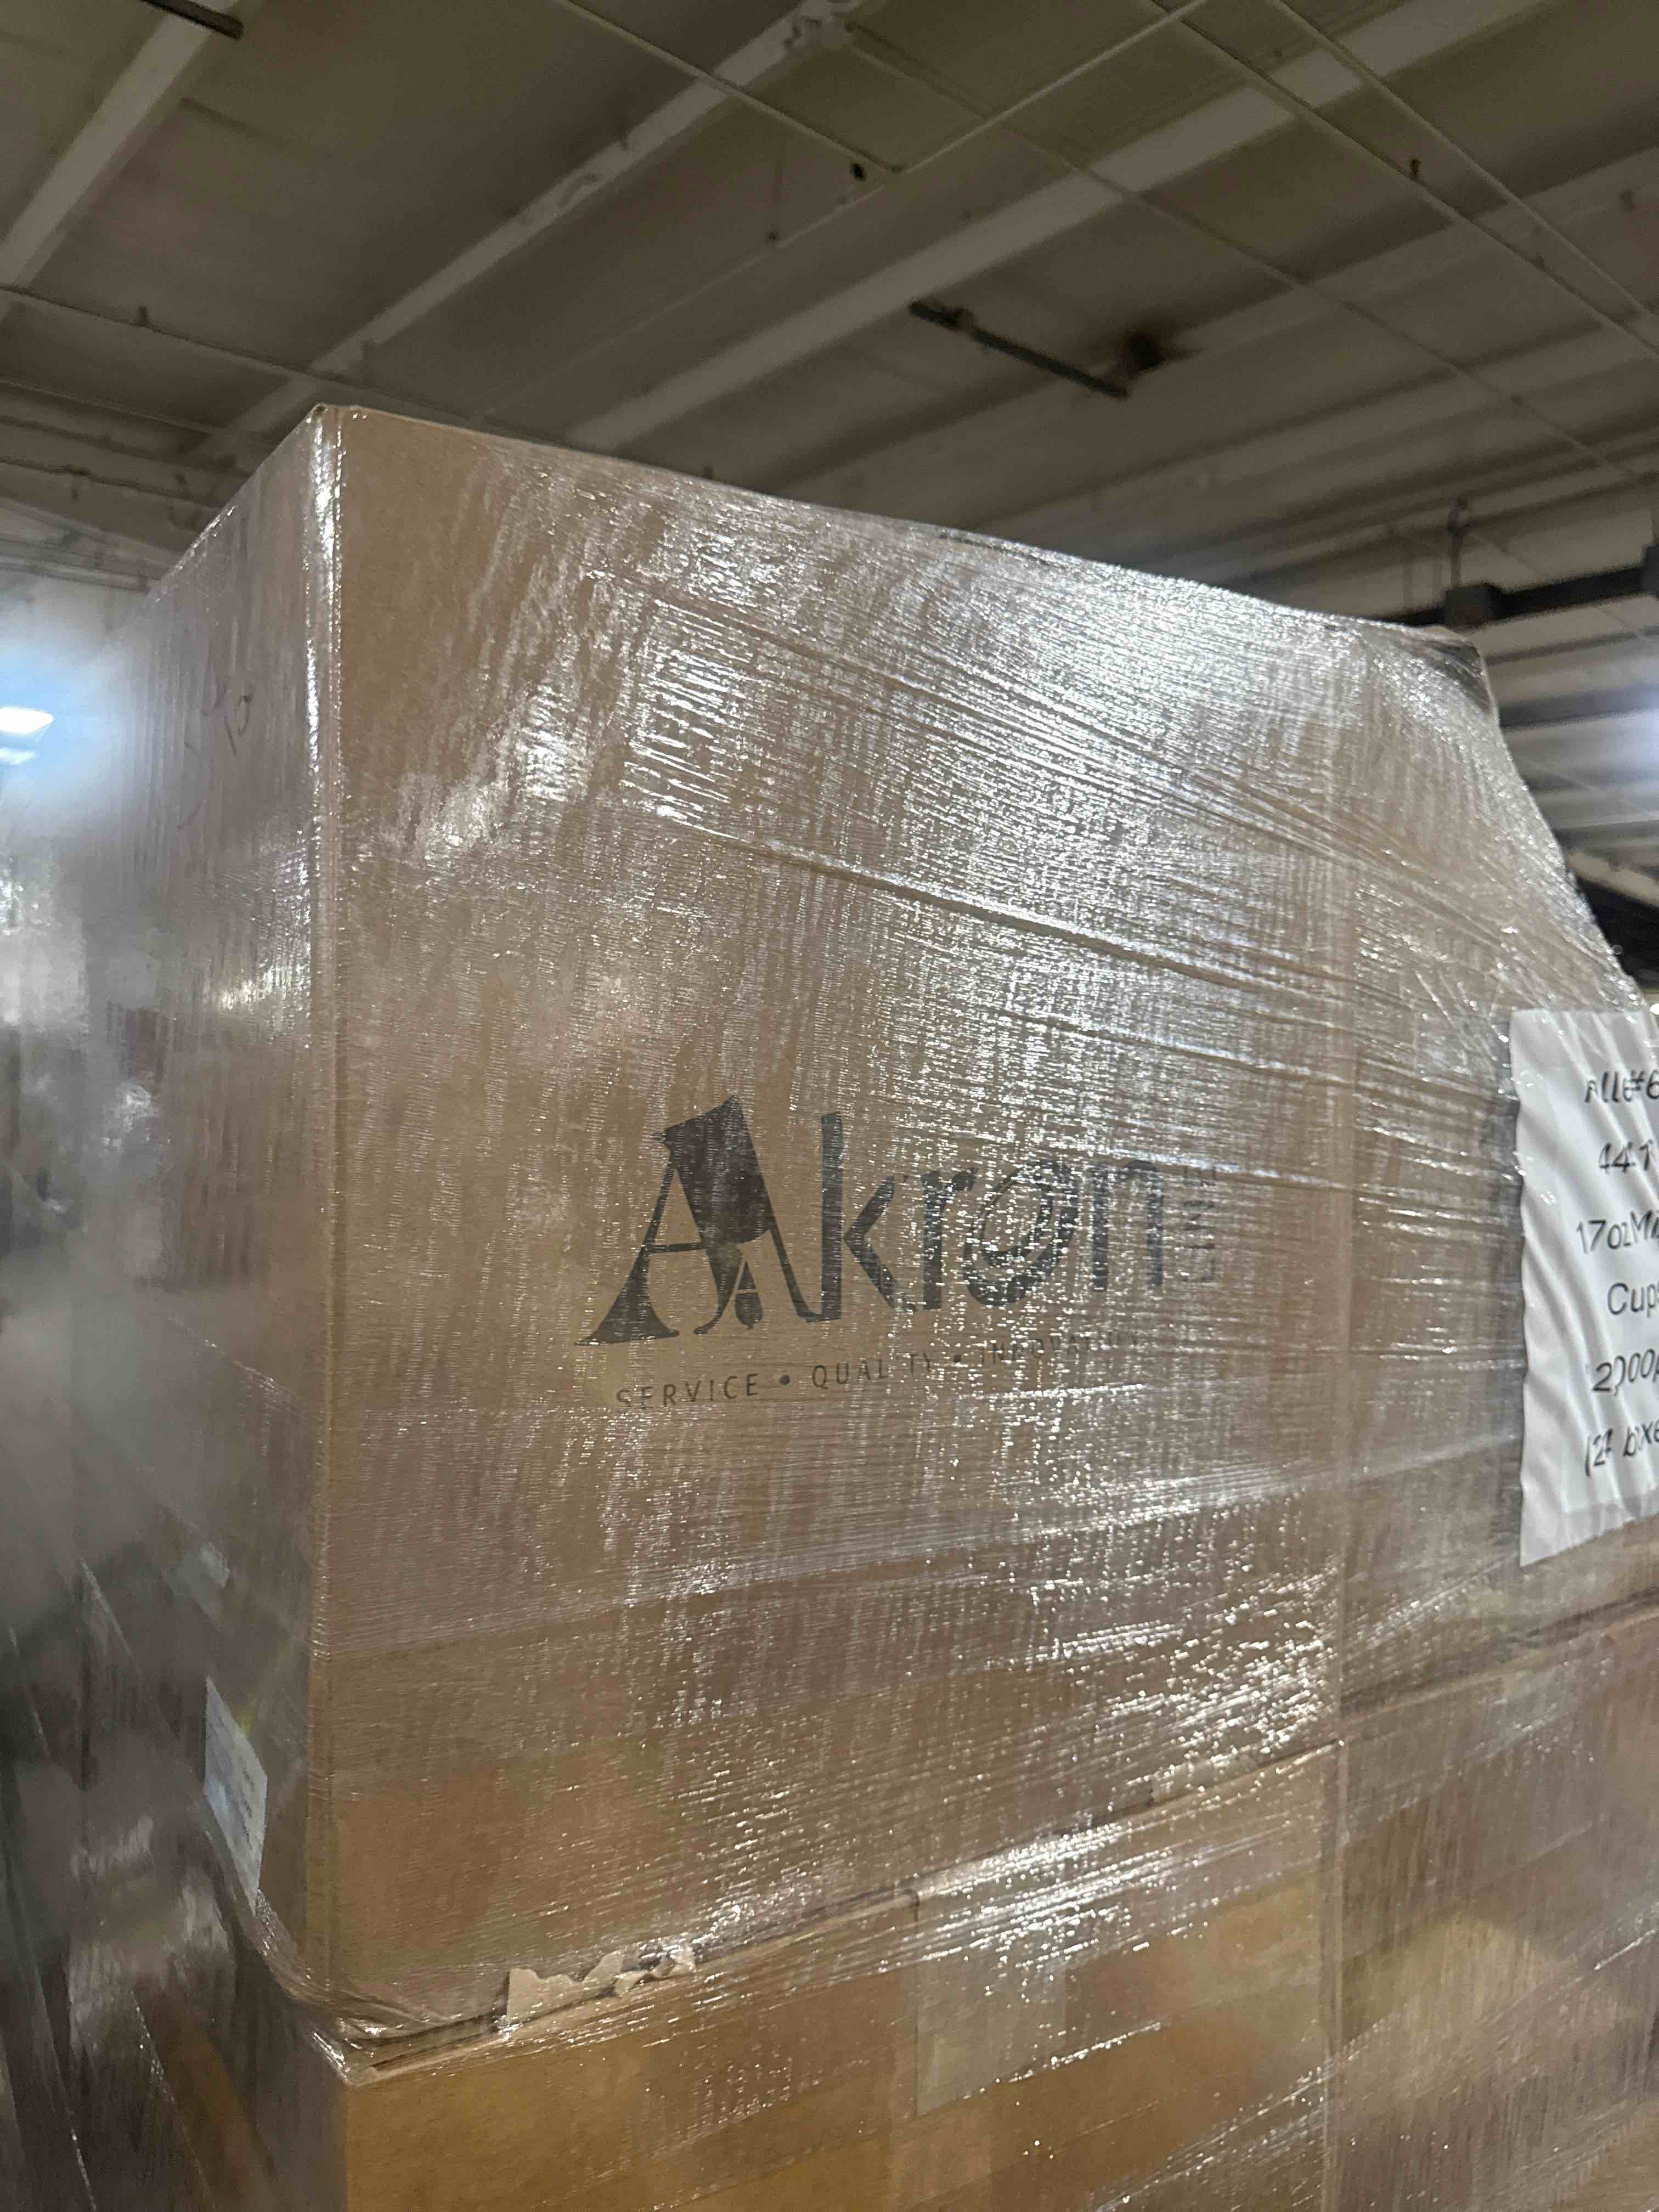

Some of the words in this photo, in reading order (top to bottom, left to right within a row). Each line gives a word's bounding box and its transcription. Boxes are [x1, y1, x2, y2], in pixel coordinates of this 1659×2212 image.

[574, 1095, 1163, 1346] Akron
[617, 1373, 759, 1409] SERVICE
[812, 1352, 932, 1389] QUALTY
[980, 1329, 1150, 1364] INNOVATON
